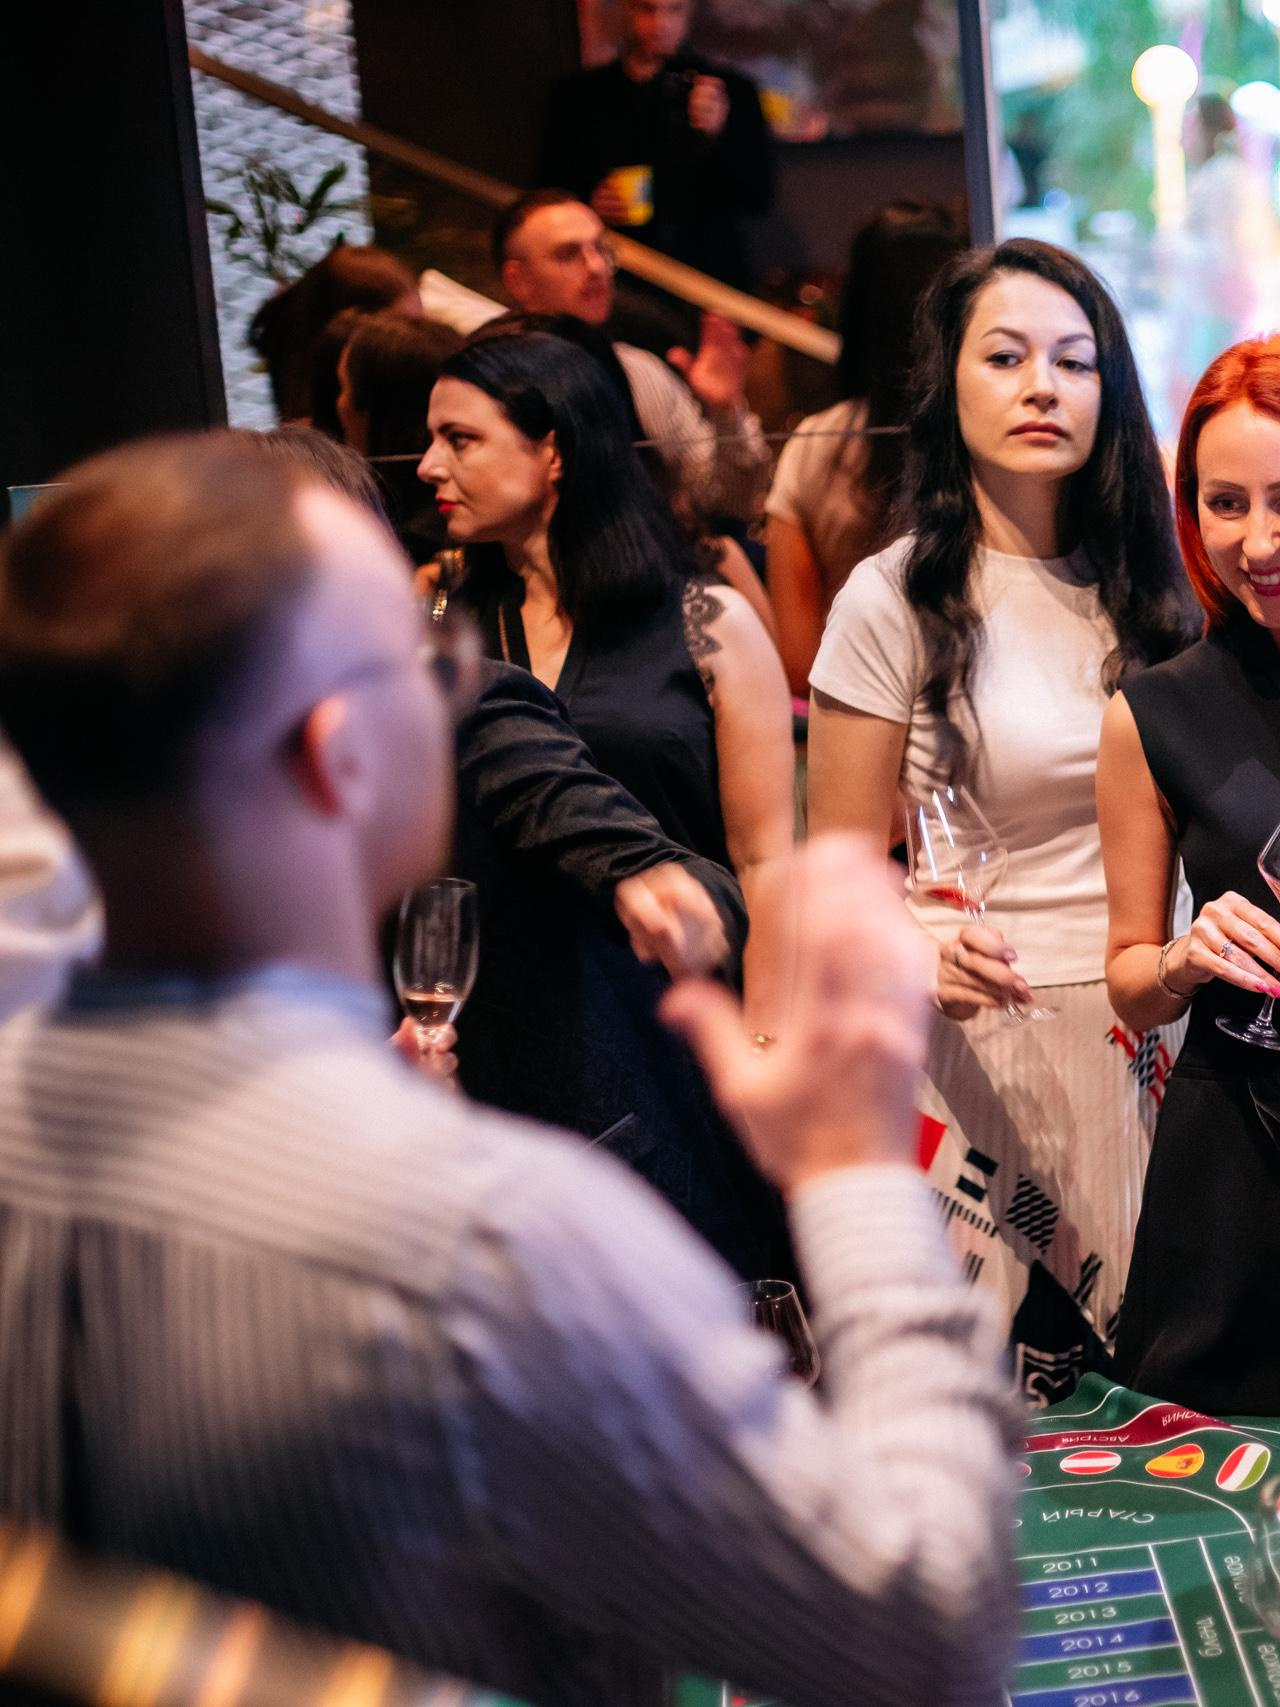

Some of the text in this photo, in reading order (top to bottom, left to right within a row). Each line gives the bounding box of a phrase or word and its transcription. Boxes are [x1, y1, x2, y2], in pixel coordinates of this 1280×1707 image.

[1061, 1434, 1130, 1444] Австрия
[1042, 1508, 1154, 1524] СТАРЫЙ
[1042, 1557, 1098, 1574] 2011
[1049, 1582, 1110, 1599] 2012
[1055, 1606, 1117, 1625] 2013
[1061, 1633, 1124, 1651] 2014
[1196, 1616, 1222, 1658] бленд
[1067, 1661, 1132, 1680] 2015
[1074, 1690, 1140, 1707] 2016
